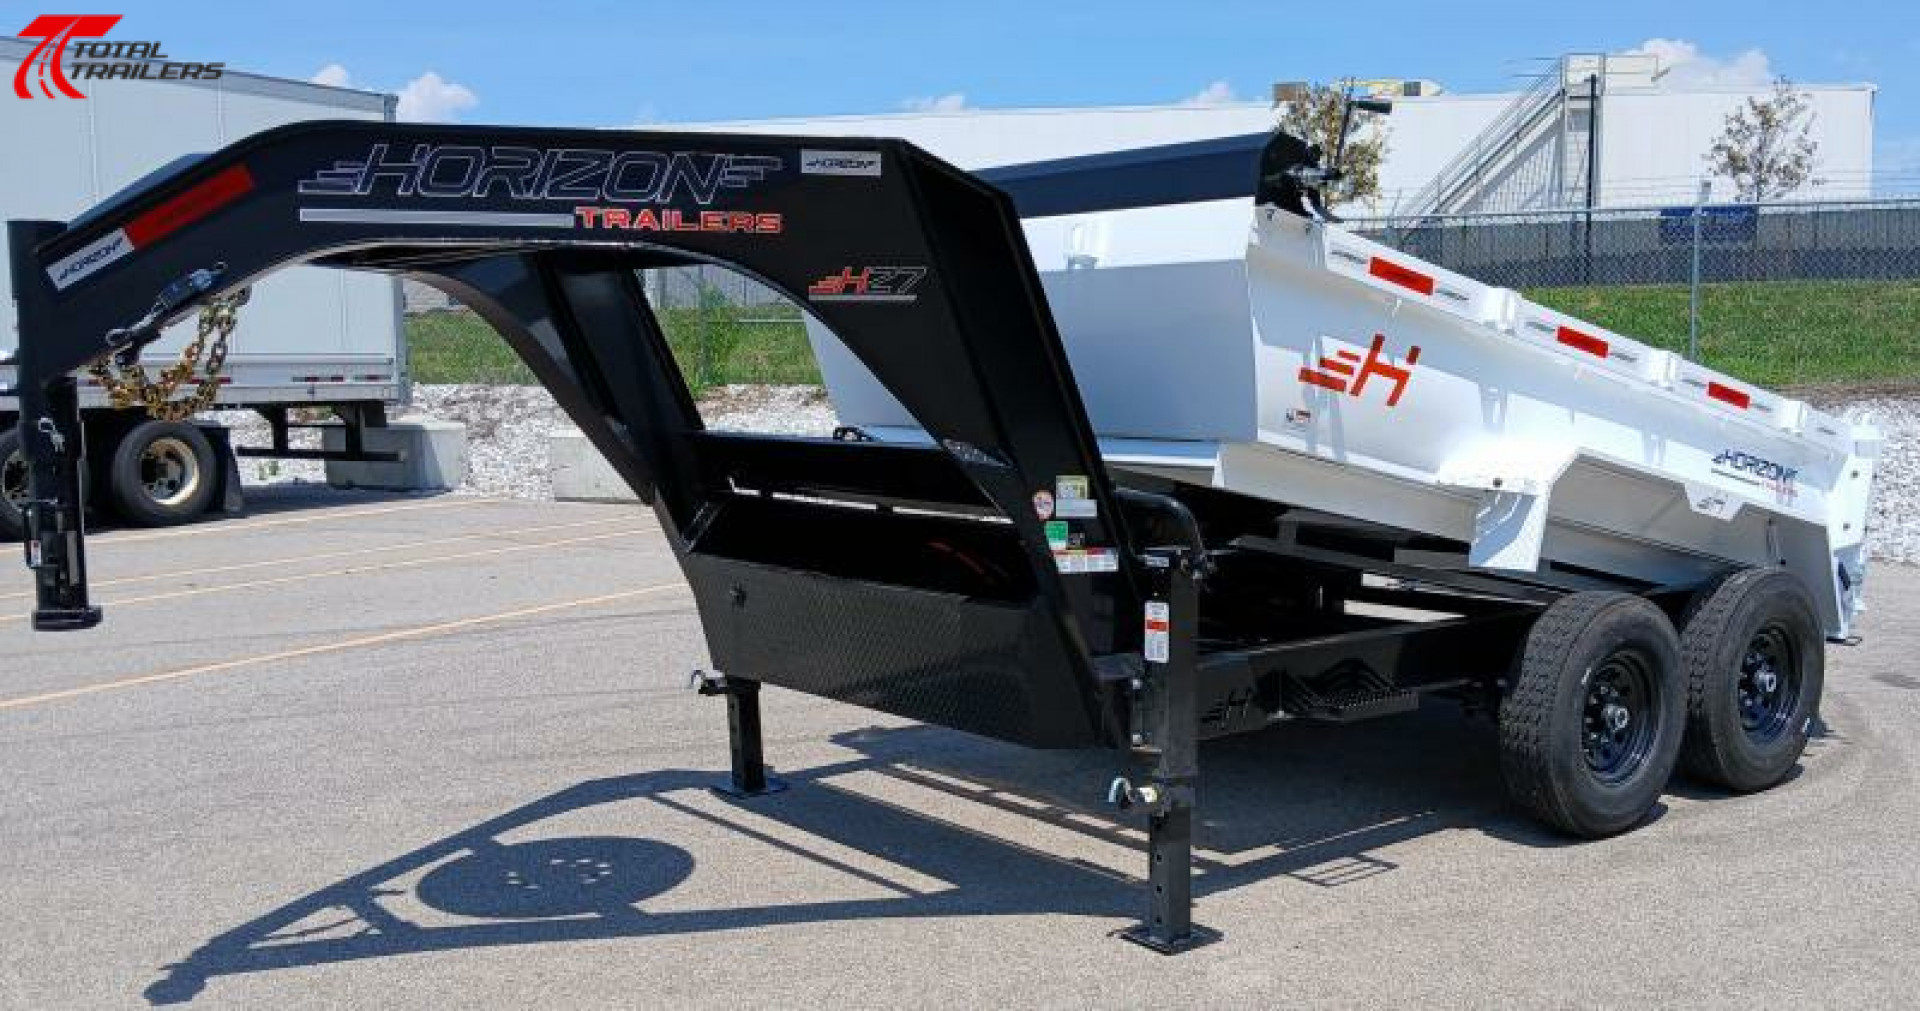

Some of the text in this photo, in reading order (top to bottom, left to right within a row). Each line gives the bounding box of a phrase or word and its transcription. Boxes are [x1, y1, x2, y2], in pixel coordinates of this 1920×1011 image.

[352, 143, 738, 204] HORIZON
[575, 206, 783, 233] TRAILERS
[837, 266, 927, 294] H27
